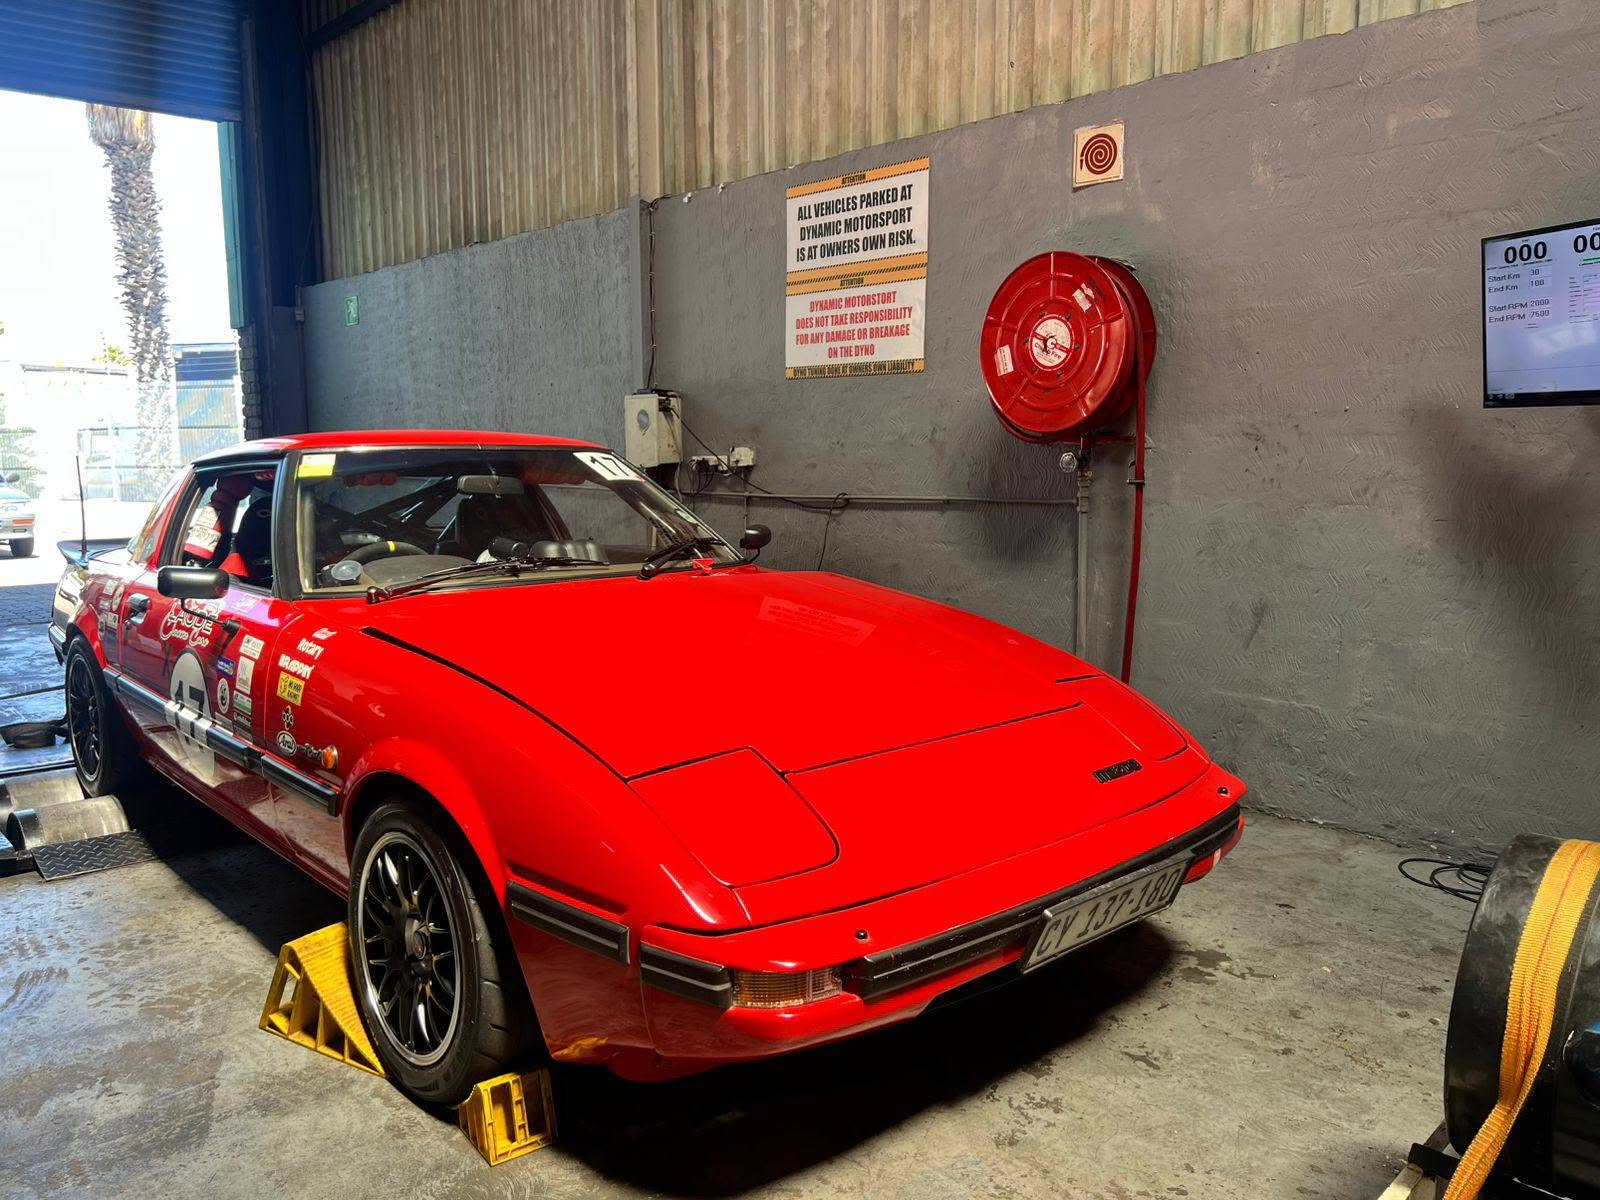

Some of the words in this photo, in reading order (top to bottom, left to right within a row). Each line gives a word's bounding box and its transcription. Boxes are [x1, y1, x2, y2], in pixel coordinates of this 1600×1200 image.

[842, 173, 866, 185] ATTENTION
[798, 204, 812, 221] ALL
[814, 196, 858, 218] VEHICLES
[860, 187, 898, 209] PARKED
[900, 184, 913, 200] AT
[800, 220, 841, 241] DYNAMIC
[844, 206, 912, 233] MOTORSPORT
[796, 248, 805, 262] IS
[807, 245, 818, 260] AT
[820, 238, 860, 258] OWNERS
[862, 233, 886, 251] OWN
[888, 229, 916, 248] RISK.
[1504, 241, 1547, 263] 000
[840, 277, 864, 286] ATTENTION
[810, 298, 842, 312] DYNAMIC
[1488, 304, 1506, 312] Start
[1508, 302, 1528, 310] RPM
[796, 318, 814, 330] DOES
[815, 316, 829, 328] NOT
[831, 314, 848, 326] TAKE
[850, 306, 912, 324] RESPONSIBILITY
[1488, 315, 1504, 323] End
[1506, 314, 1526, 322] RPM
[1530, 310, 1550, 318] 7500
[796, 334, 808, 345] FOR
[810, 332, 824, 344] ANY
[826, 329, 855, 342] DAMAGE
[857, 328, 868, 340] OR
[870, 324, 910, 339] BREAKAGE
[828, 346, 838, 358] ON
[840, 345, 852, 358] THE
[854, 344, 874, 356] DYNO
[848, 363, 872, 374] OWNERS
[873, 362, 886, 373] OWN
[888, 360, 914, 372] LIABILITY
[590, 455, 629, 477] 17
[296, 638, 324, 660] Rotary
[1037, 911, 1080, 956] CY
[1077, 868, 1181, 939] 137-180
